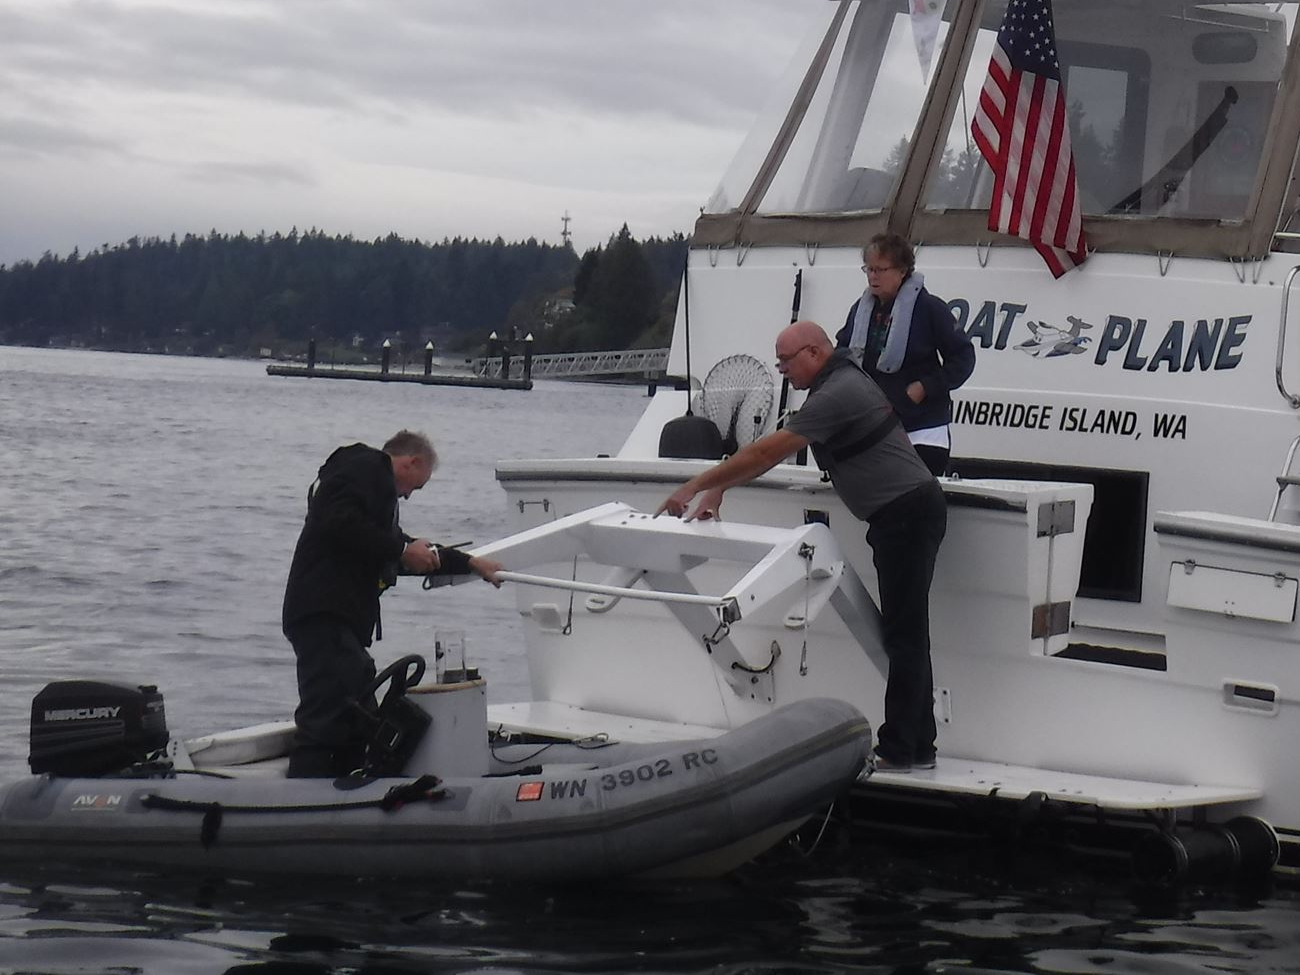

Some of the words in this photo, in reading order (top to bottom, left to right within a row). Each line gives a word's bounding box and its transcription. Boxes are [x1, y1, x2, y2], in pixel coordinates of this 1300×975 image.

[1094, 314, 1253, 373] PLANE
[1059, 407, 1142, 440] ISLAND,
[1152, 413, 1187, 440] WA
[44, 706, 121, 722] MERCURY
[551, 778, 588, 800] WN
[601, 758, 673, 792] 3902
[682, 748, 719, 770] RC
